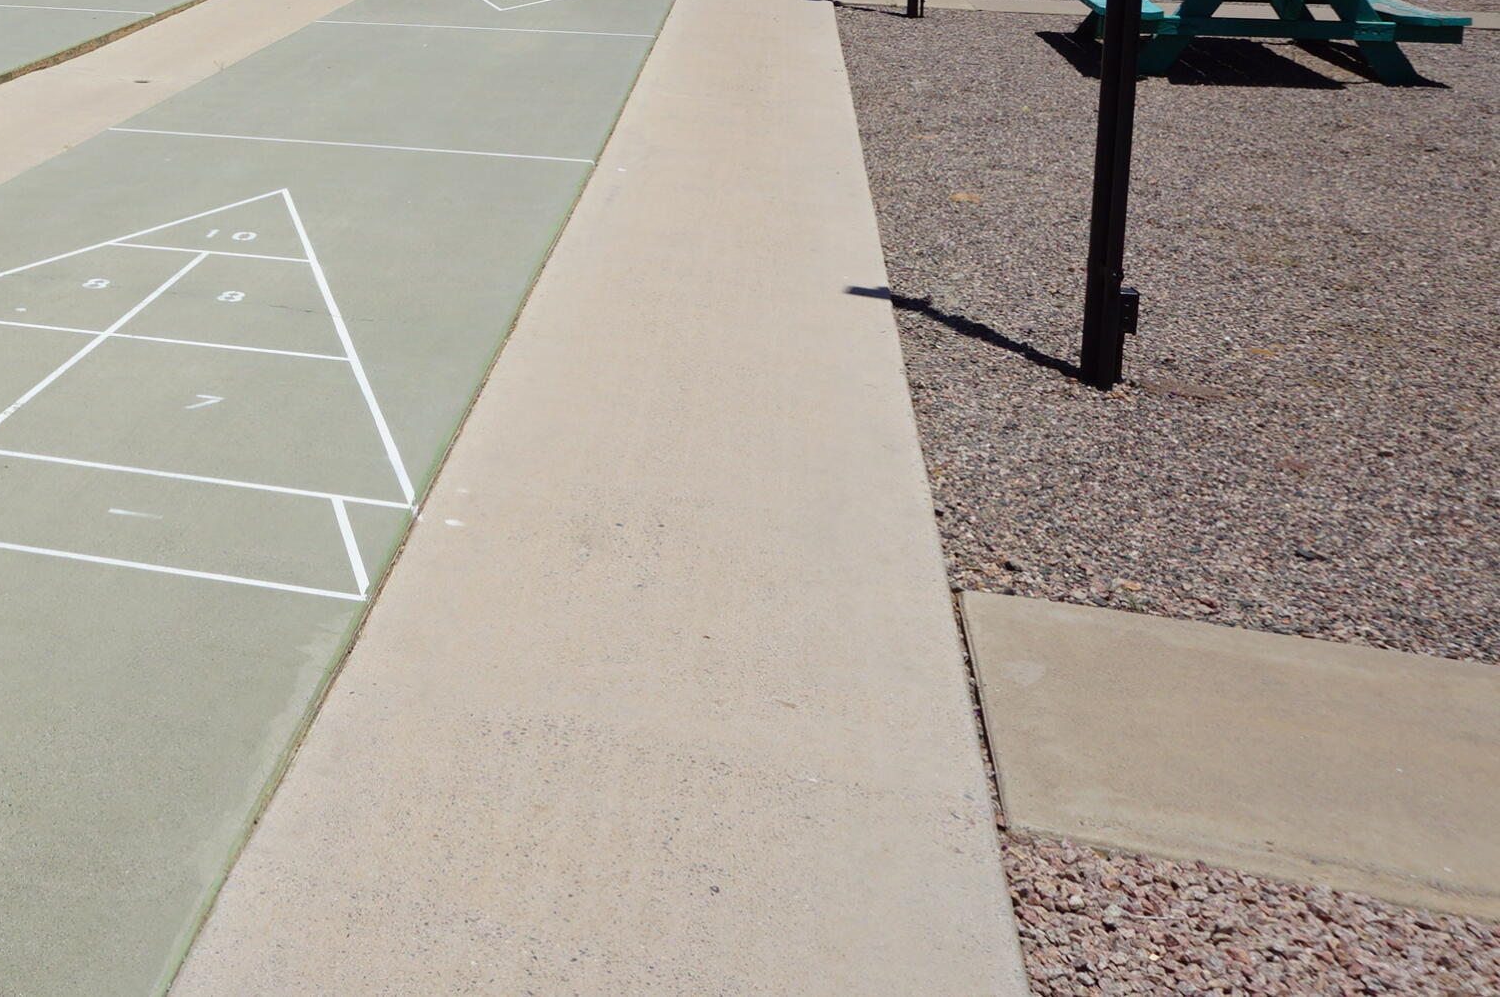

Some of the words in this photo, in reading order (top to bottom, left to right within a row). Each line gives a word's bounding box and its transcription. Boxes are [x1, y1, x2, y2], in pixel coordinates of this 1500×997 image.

[204, 229, 257, 241] 10
[82, 278, 111, 289] 8
[216, 290, 246, 302] 8
[183, 394, 225, 409] 7
